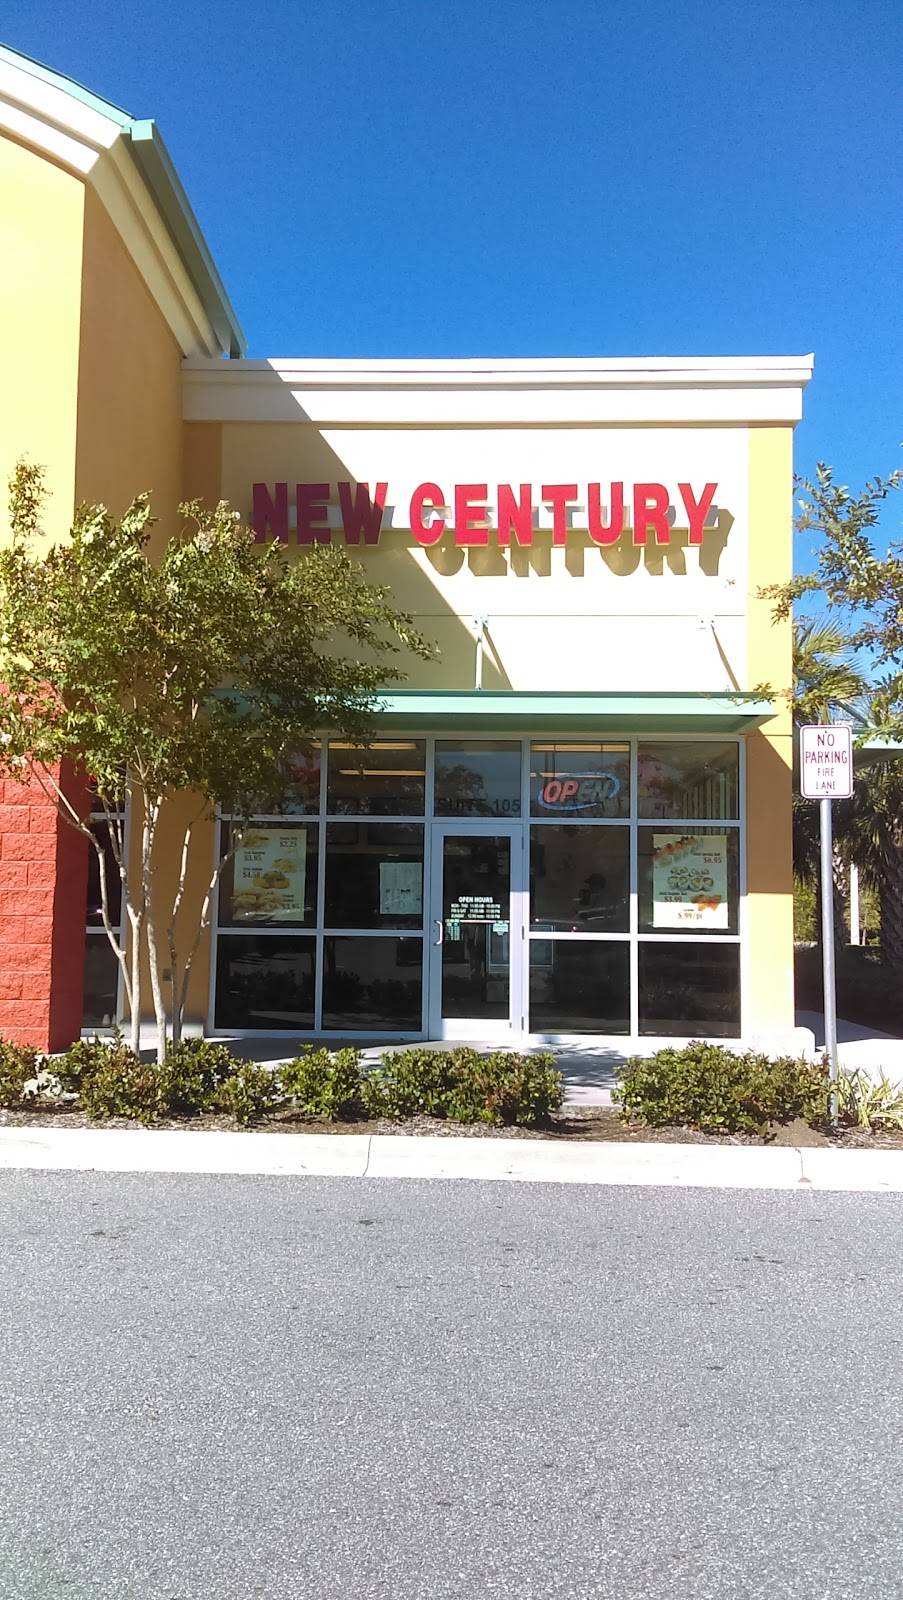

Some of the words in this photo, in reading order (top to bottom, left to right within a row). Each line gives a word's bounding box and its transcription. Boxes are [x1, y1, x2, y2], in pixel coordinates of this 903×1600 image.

[252, 482, 389, 546] NEW
[409, 482, 718, 547] CENTURY
[817, 733, 835, 747] NO
[805, 750, 848, 764] PARKING
[817, 767, 835, 777] FIRE
[543, 779, 610, 803] OPEN
[815, 781, 836, 790] LANE
[494, 798, 521, 812] 105
